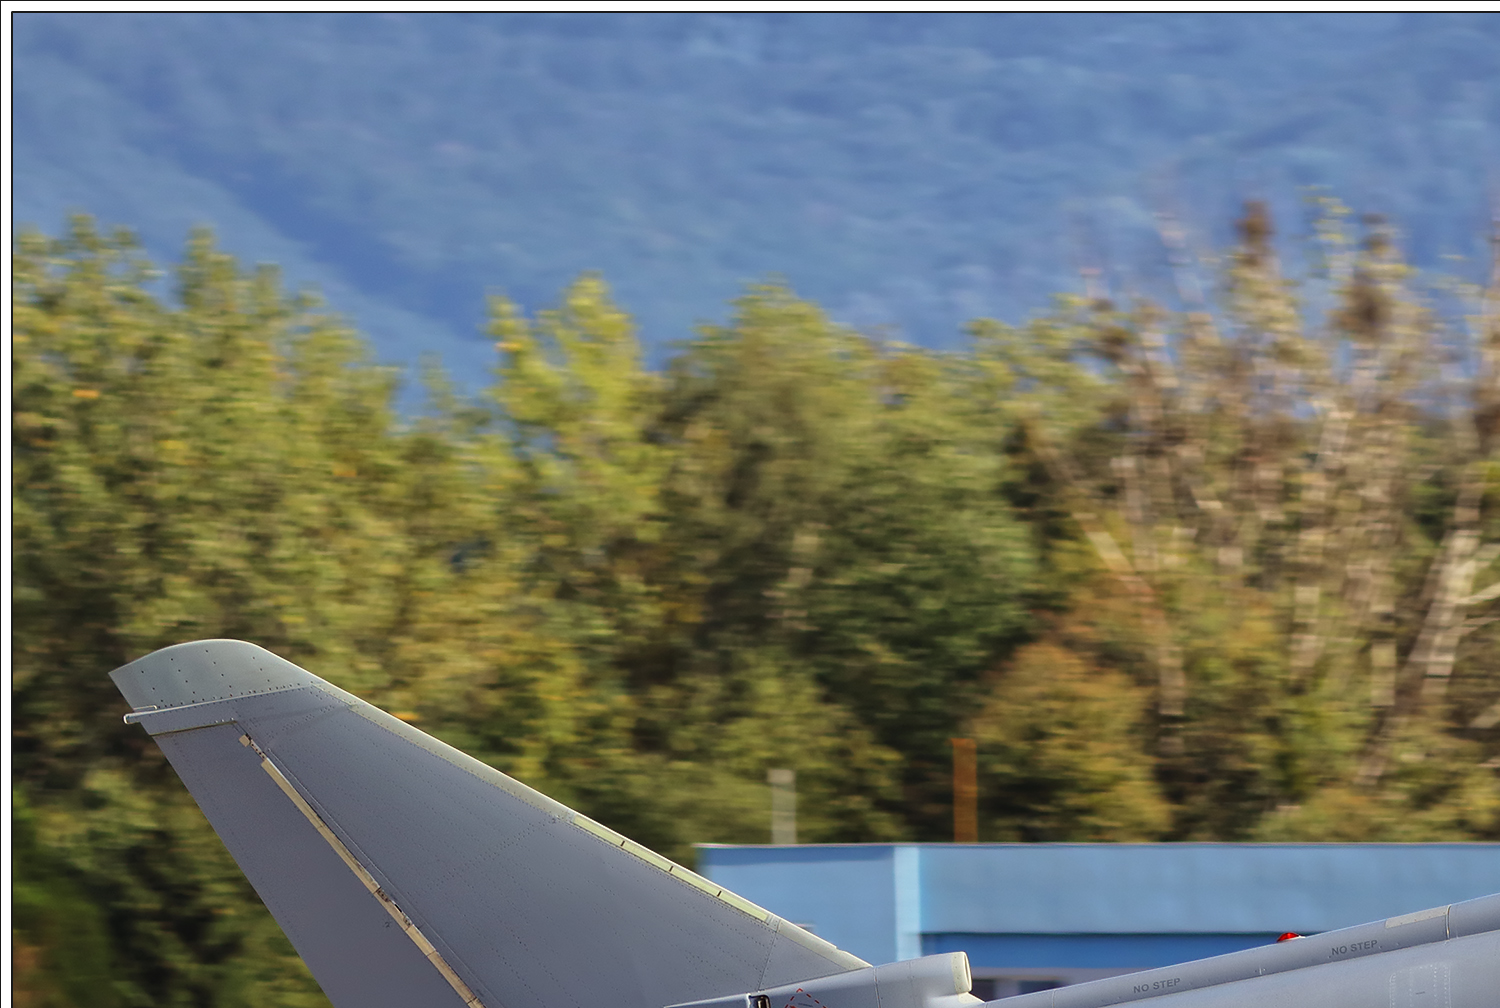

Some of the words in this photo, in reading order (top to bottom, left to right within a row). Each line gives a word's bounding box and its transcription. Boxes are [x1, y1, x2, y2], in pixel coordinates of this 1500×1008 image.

[1331, 944, 1348, 956] NO
[1350, 939, 1378, 952] STEP
[1133, 983, 1149, 994] NO
[1153, 977, 1181, 990] STEP
